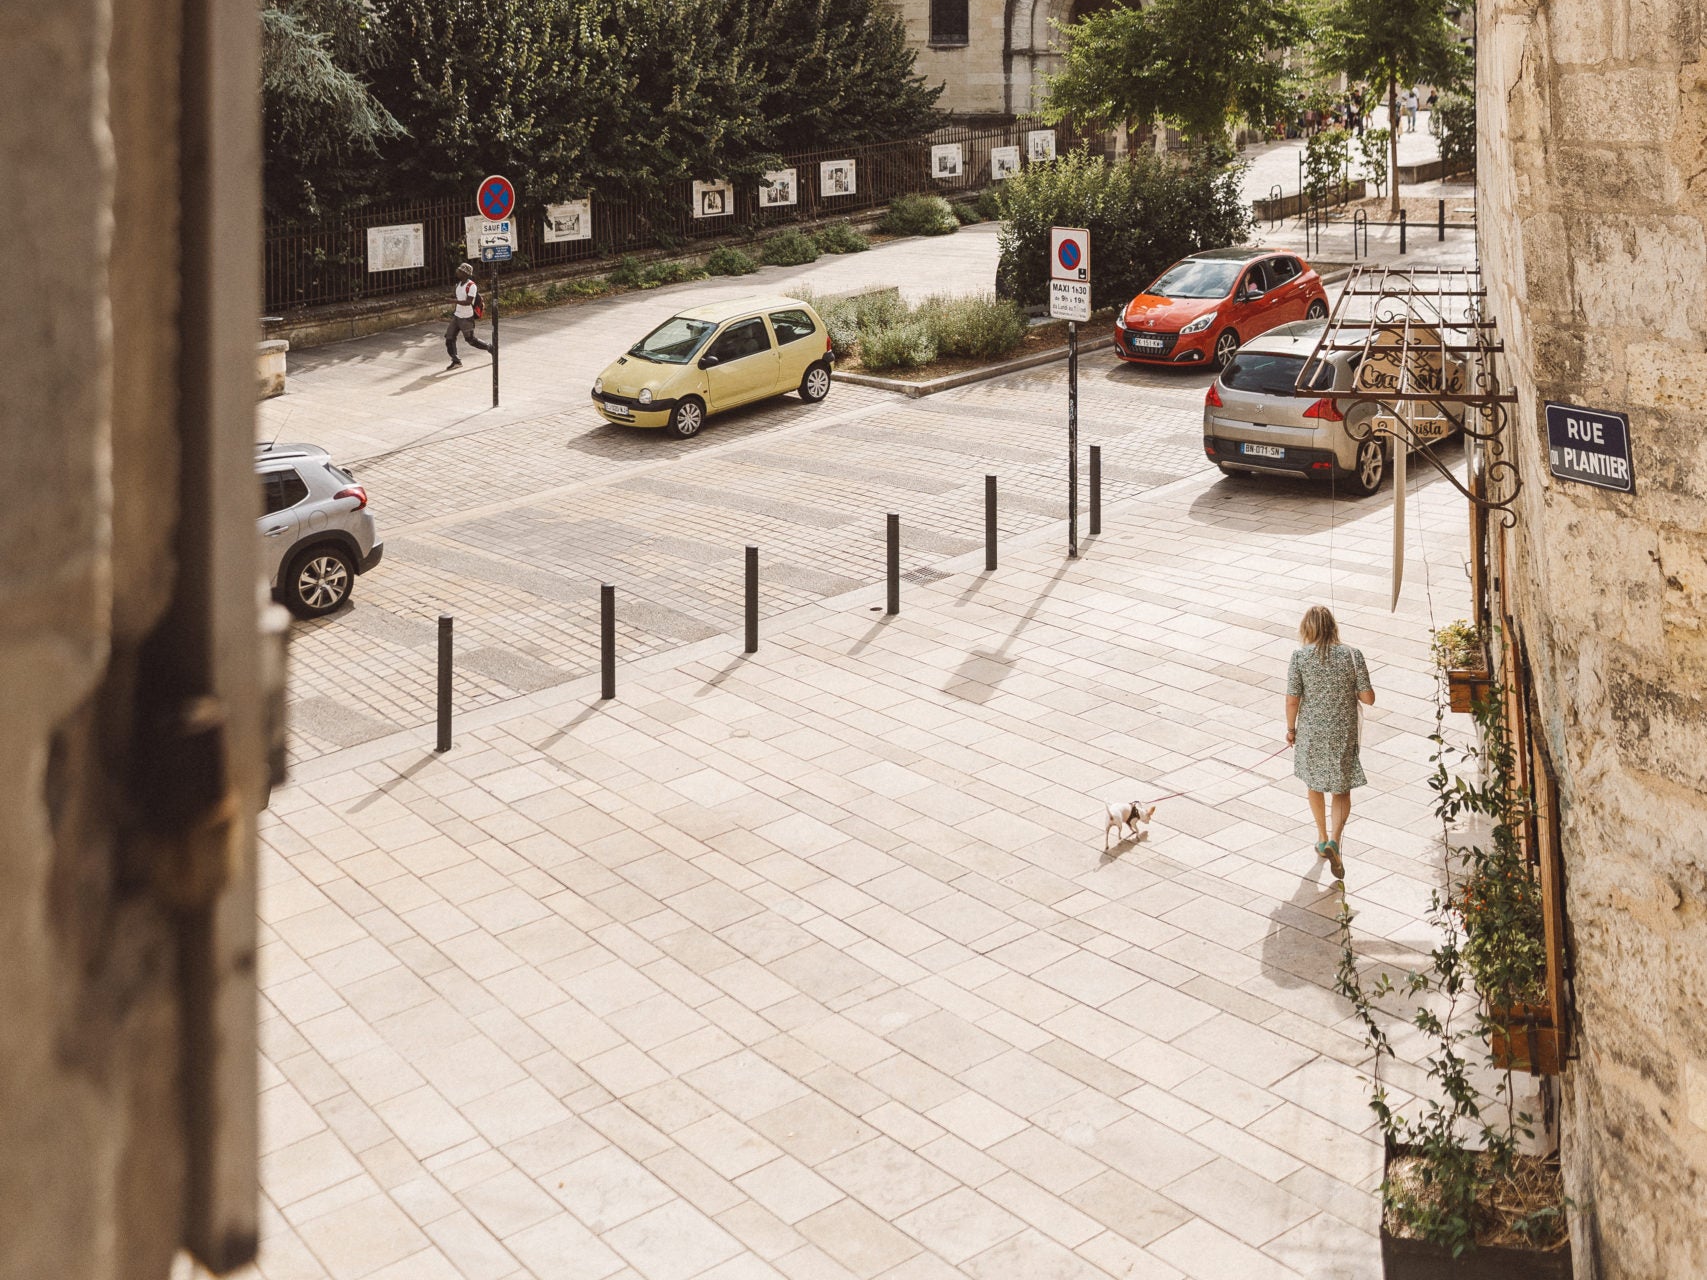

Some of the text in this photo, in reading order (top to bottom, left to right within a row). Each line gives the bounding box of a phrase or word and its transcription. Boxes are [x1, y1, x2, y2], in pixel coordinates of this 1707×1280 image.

[484, 224, 500, 232] SAUF
[1053, 283, 1086, 295] MAXI 1h30
[1061, 294, 1069, 302] 9h
[1566, 417, 1605, 445] RUE
[1563, 447, 1629, 480] PLANTIER
